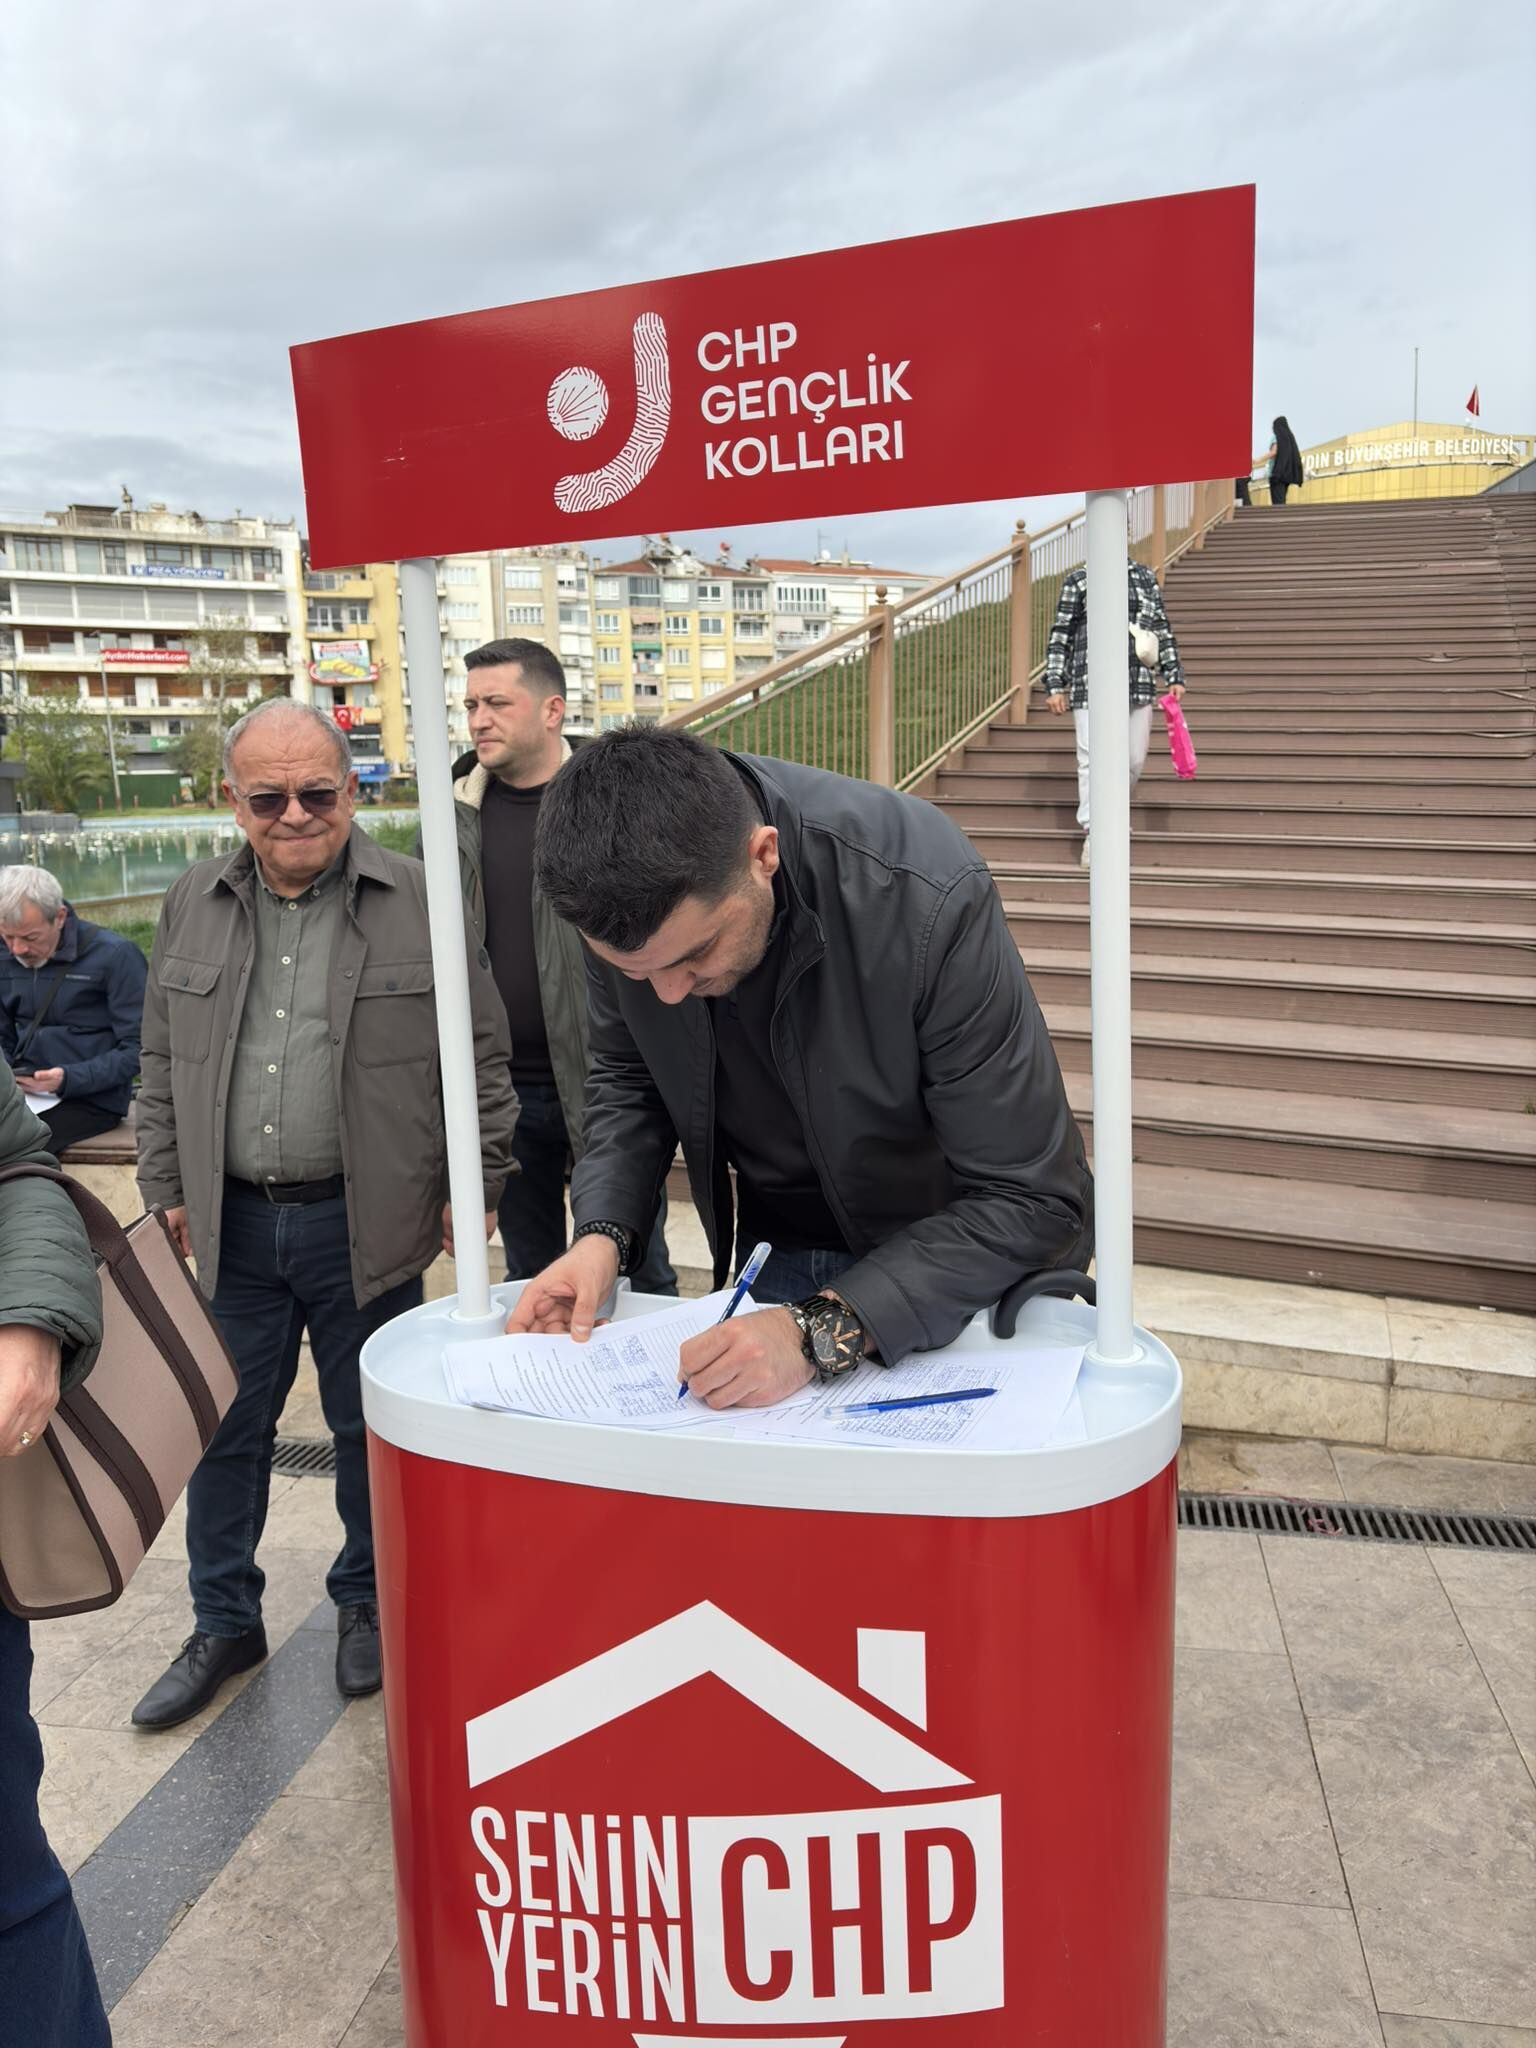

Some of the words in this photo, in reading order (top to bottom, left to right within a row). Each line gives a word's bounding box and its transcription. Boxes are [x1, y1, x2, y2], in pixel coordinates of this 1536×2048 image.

[697, 321, 797, 372] CHP
[700, 353, 913, 424] GENÇLİK
[705, 420, 904, 480] KOLLARI
[1435, 434, 1514, 456] BELEDİYESİ
[470, 1806, 681, 1919] SENİN
[721, 1826, 977, 2002] CHP
[476, 1908, 686, 2023] YERİN
